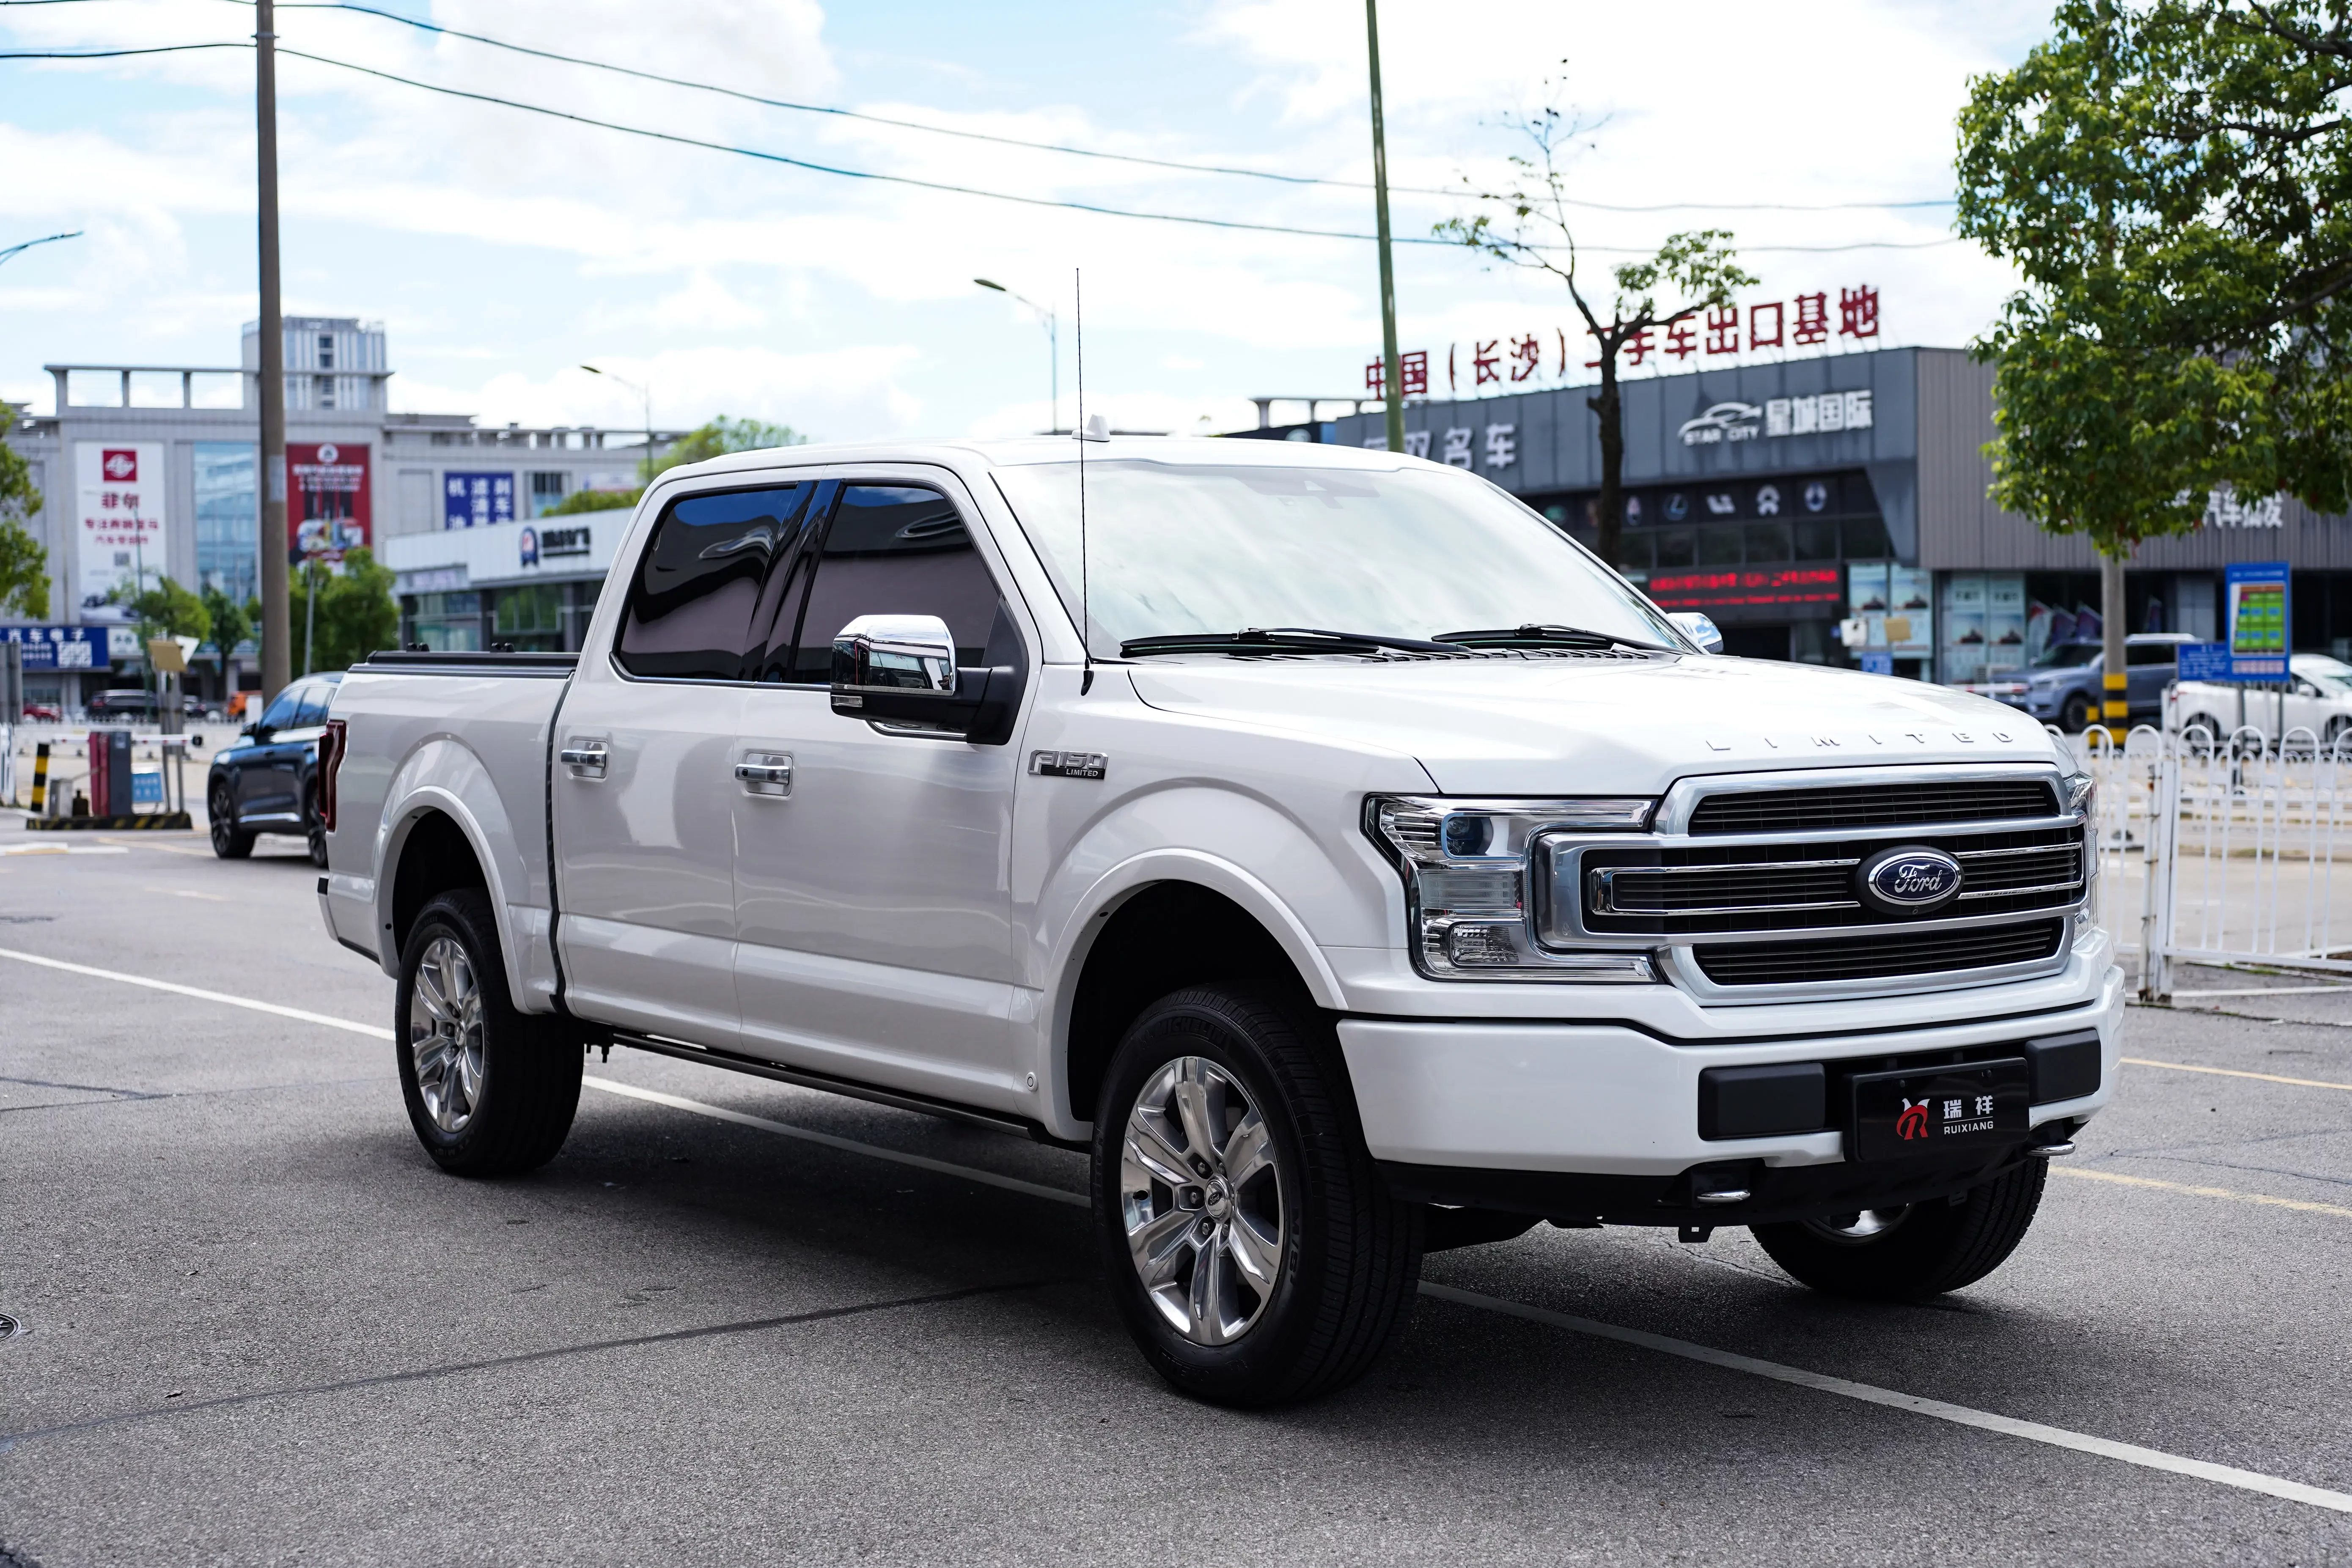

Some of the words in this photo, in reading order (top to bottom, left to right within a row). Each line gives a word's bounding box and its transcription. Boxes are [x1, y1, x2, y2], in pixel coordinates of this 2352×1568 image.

[1766, 390, 1872, 437] 星城国际
[1706, 732, 2014, 751] LIMITED
[1066, 769, 1099, 777] LIMITED
[1894, 864, 1943, 893] Ford
[1943, 1095, 1993, 1119] 瑞祥
[1944, 1121, 1994, 1135] RUIXIANG
[1209, 1194, 1220, 1205] Ford
